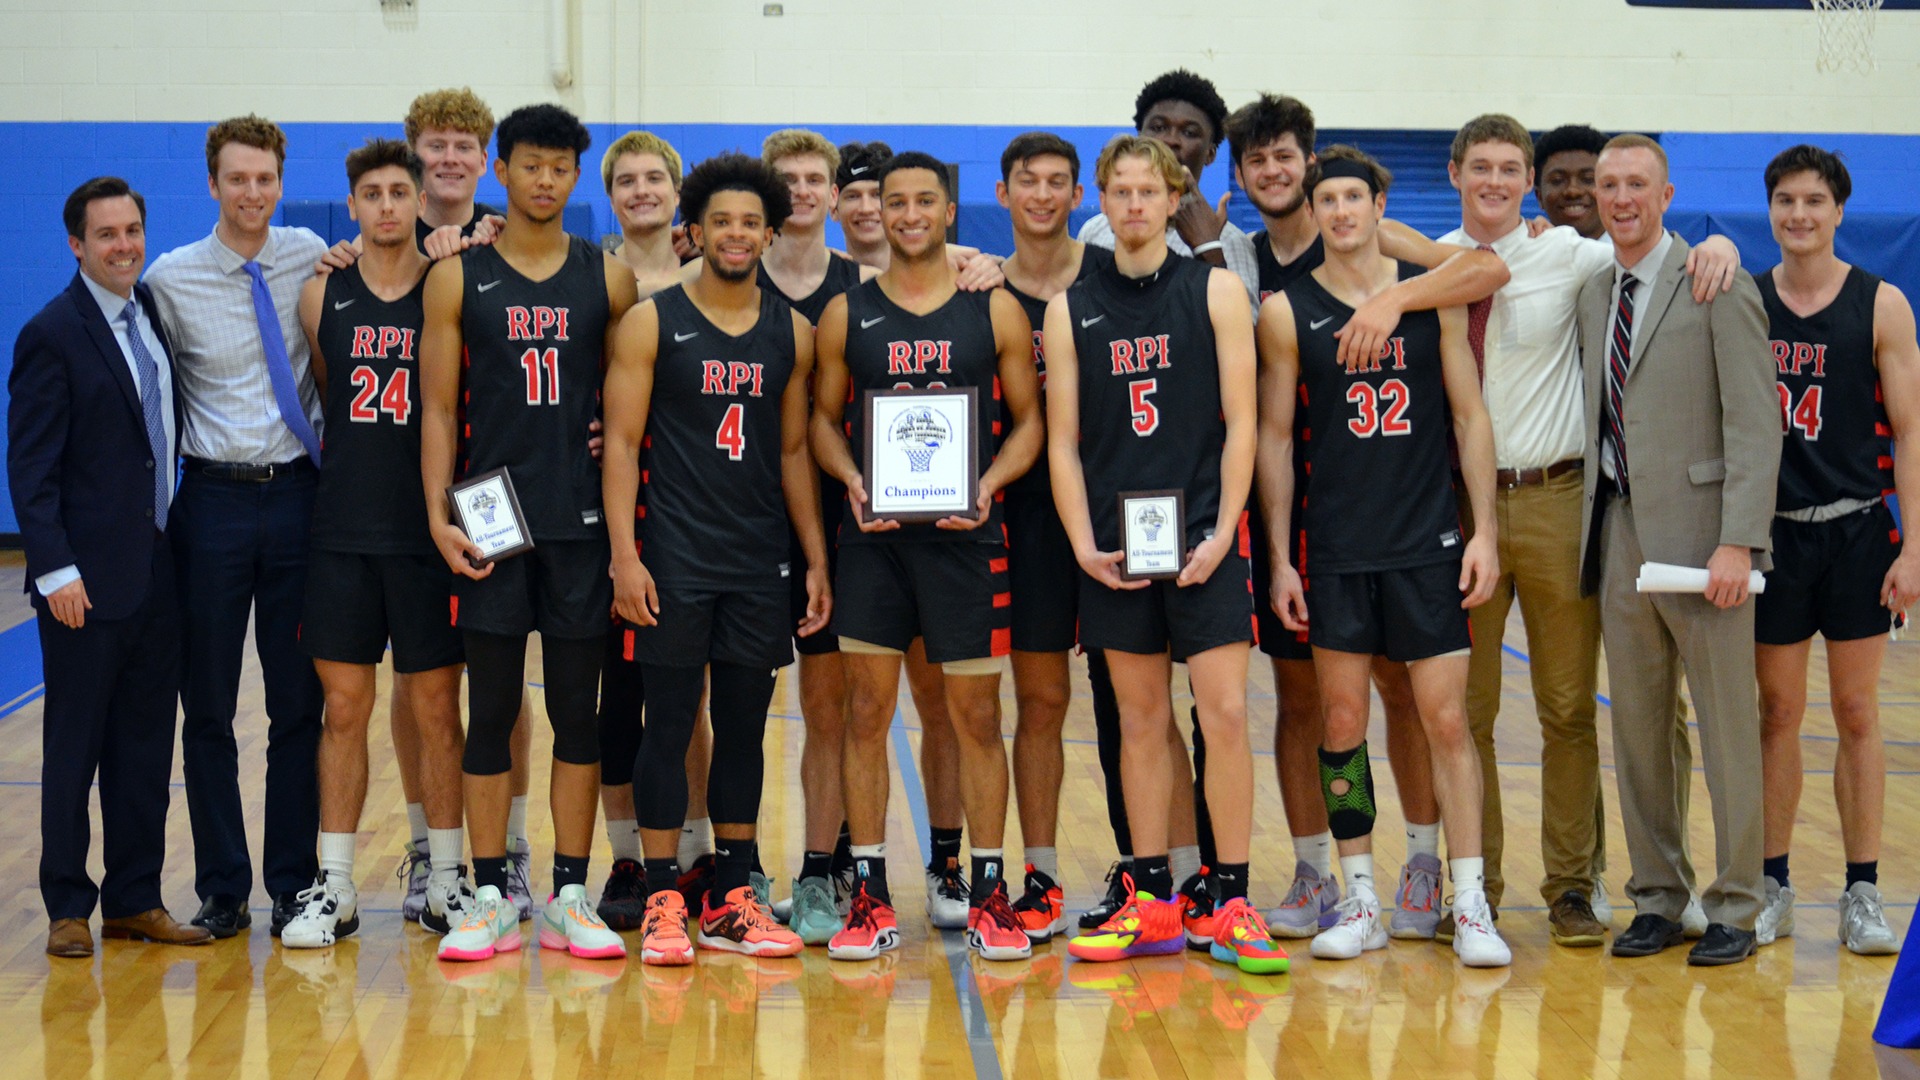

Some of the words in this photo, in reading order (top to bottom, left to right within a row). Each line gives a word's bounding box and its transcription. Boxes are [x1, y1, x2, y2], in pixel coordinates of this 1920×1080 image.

[505, 305, 570, 341] RPI
[350, 325, 416, 361] RPI
[887, 339, 952, 375] RPI
[1109, 334, 1172, 376] RPI
[520, 347, 560, 405] 11
[700, 360, 764, 397] RPI
[350, 365, 412, 425] 24
[1128, 377, 1159, 437] 5
[1346, 378, 1411, 439] 32
[716, 403, 745, 461] 4
[884, 484, 957, 500] Champions
[475, 524, 515, 544] All-Tournament
[491, 539, 506, 549] Team
[1131, 548, 1174, 557] All-Tournament
